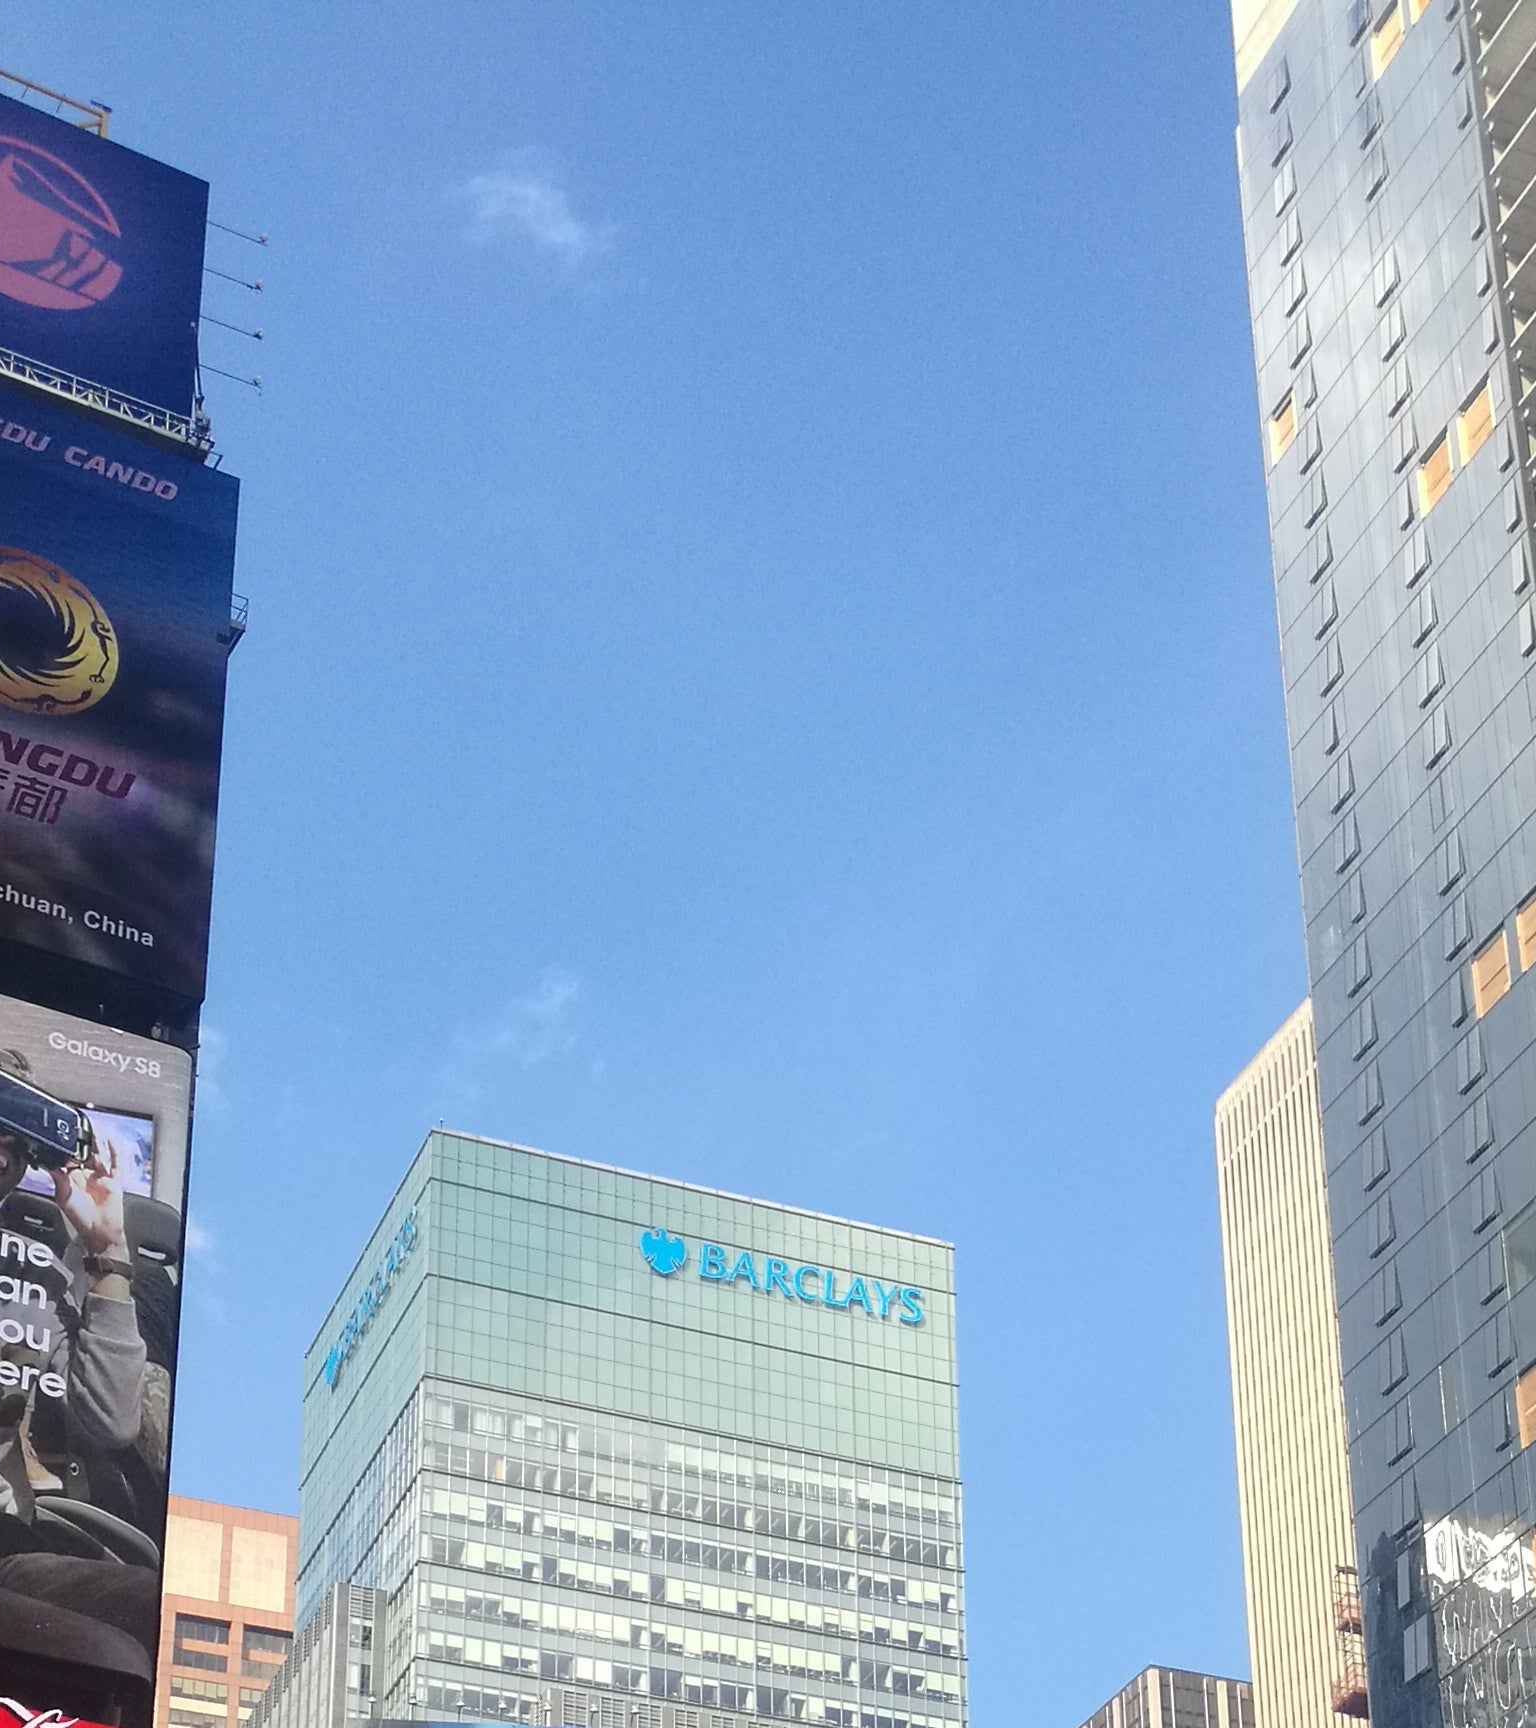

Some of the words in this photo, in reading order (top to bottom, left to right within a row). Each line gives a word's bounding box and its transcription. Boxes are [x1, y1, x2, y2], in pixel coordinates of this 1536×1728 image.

[64, 445, 178, 502] CANDO
[83, 908, 155, 950] China
[48, 1031, 131, 1075] Galaxy
[134, 1055, 162, 1079] S8
[699, 1243, 925, 1326] BARCLAYS
